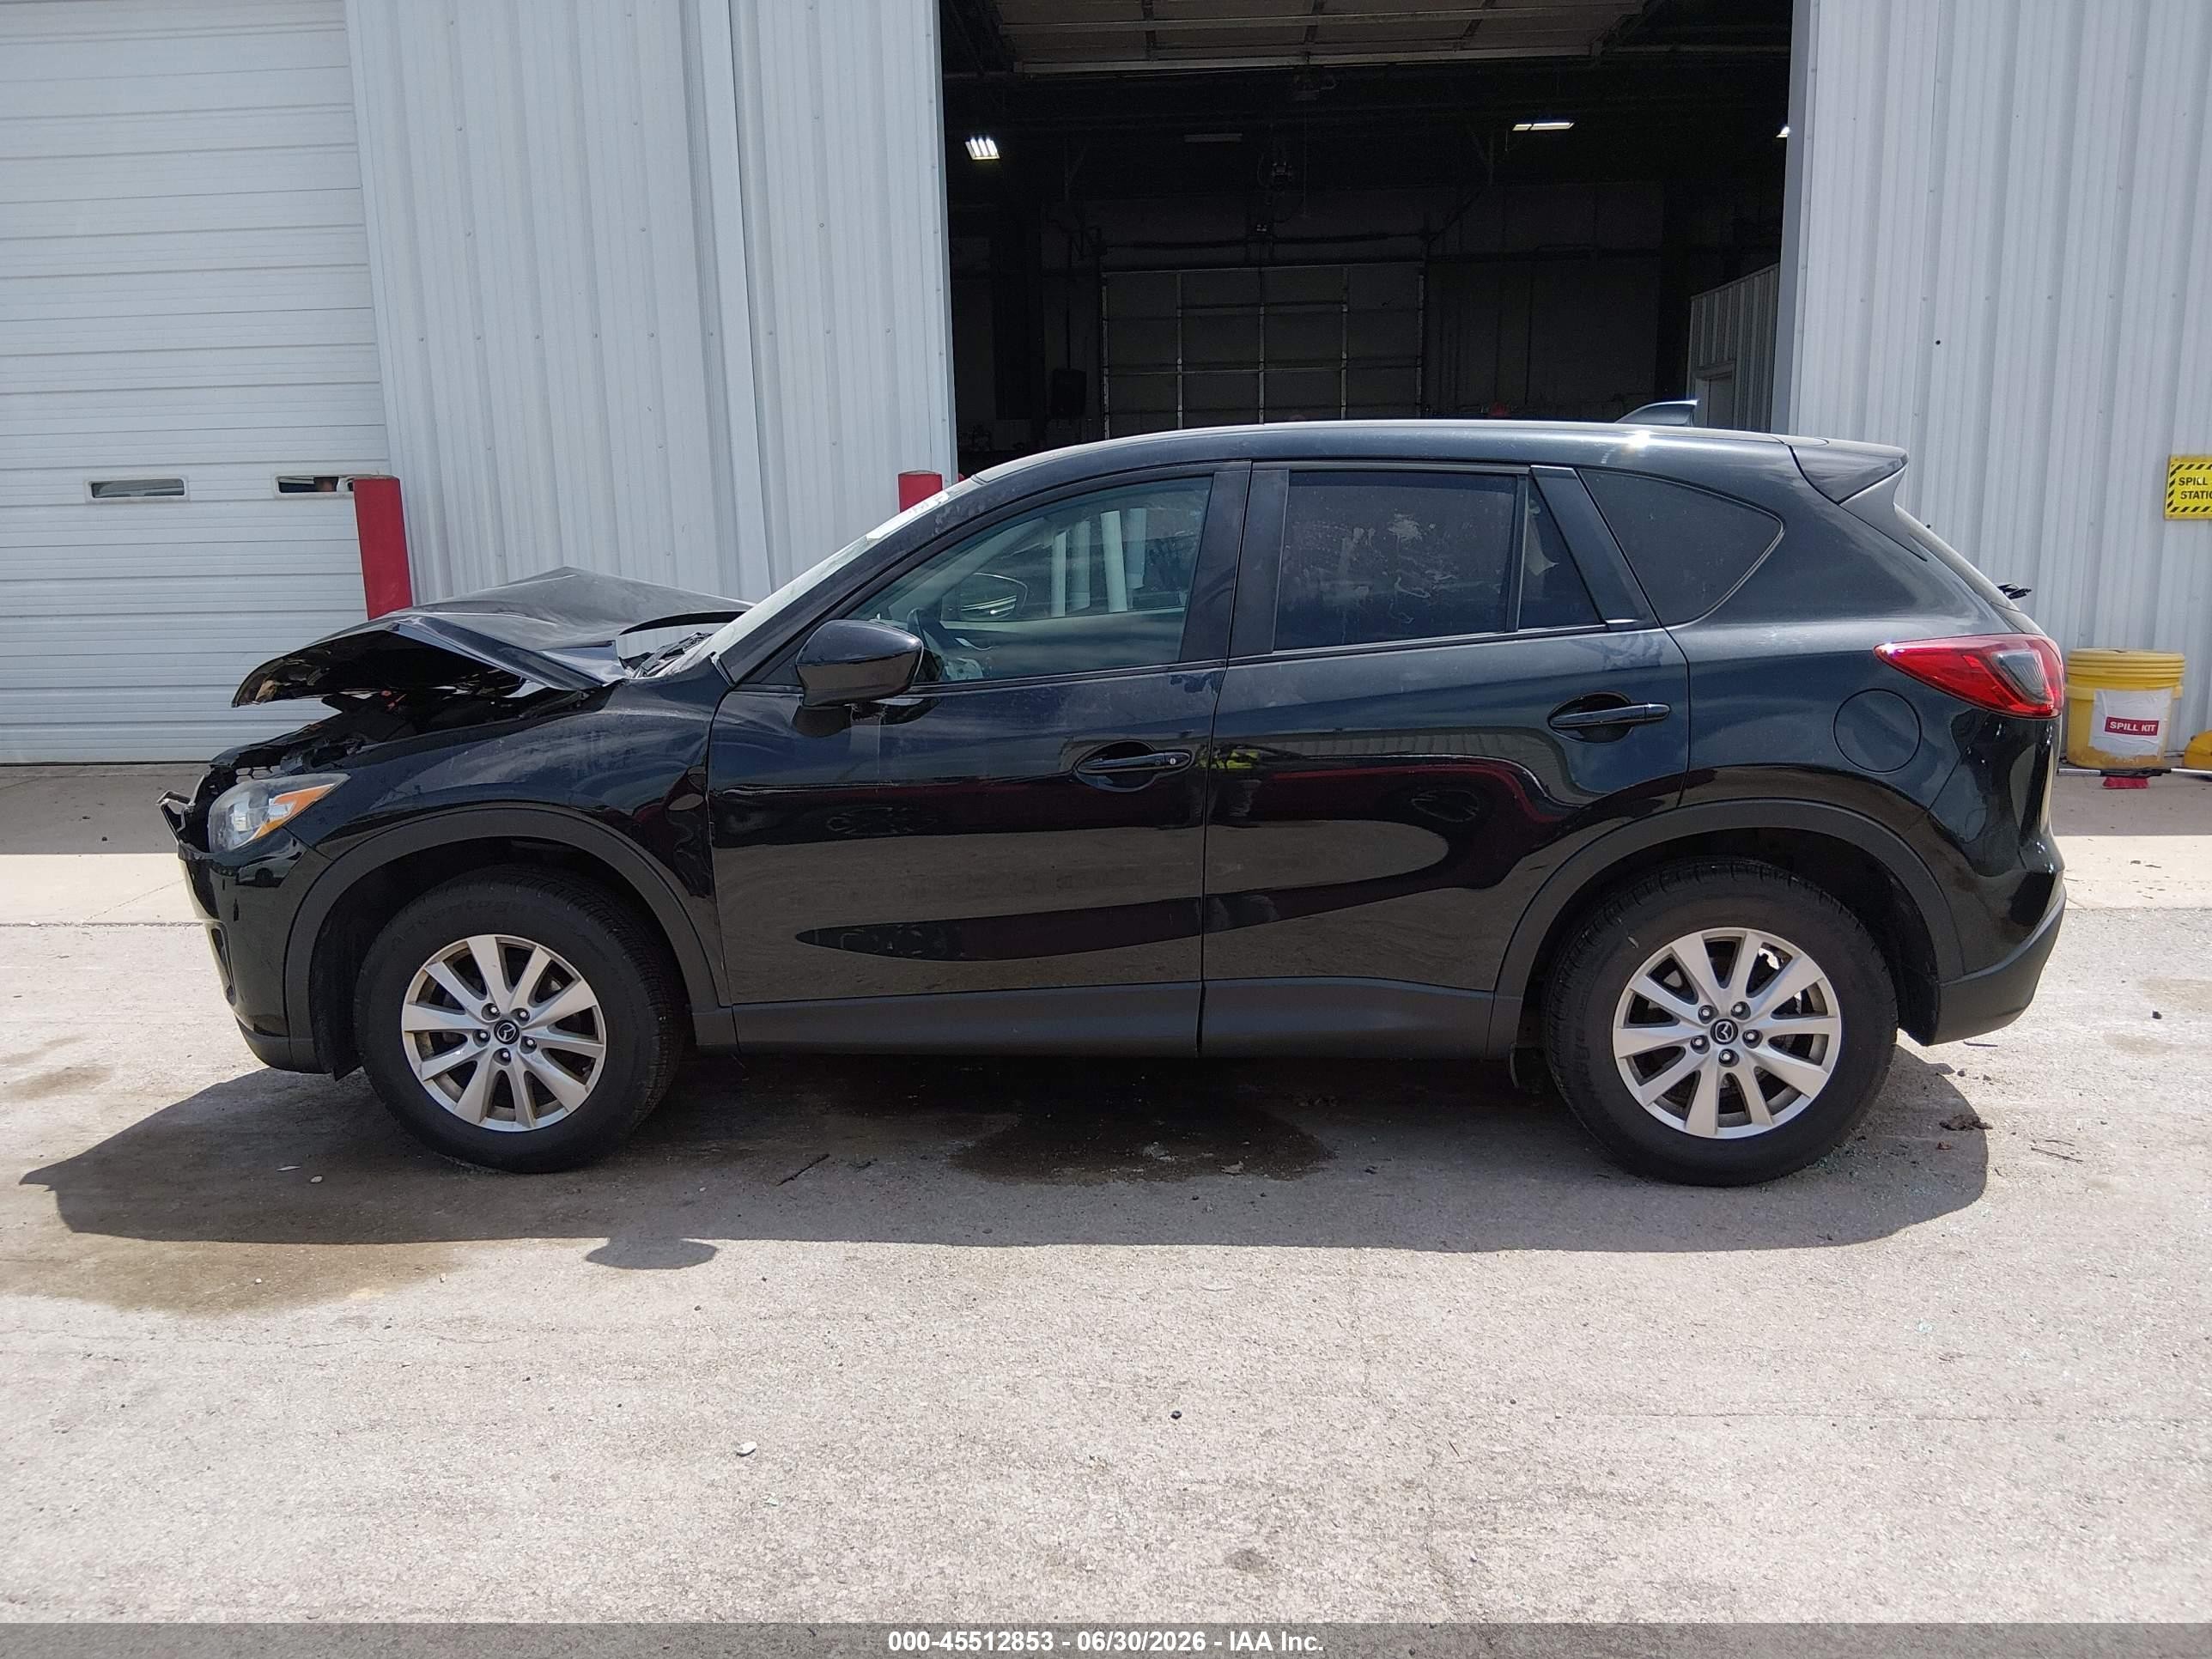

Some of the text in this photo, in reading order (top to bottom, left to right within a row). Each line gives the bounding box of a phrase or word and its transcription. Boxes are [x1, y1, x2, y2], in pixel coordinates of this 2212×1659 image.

[2179, 477, 2208, 486] SPILL
[2109, 721, 2156, 732] SPILL KIT
